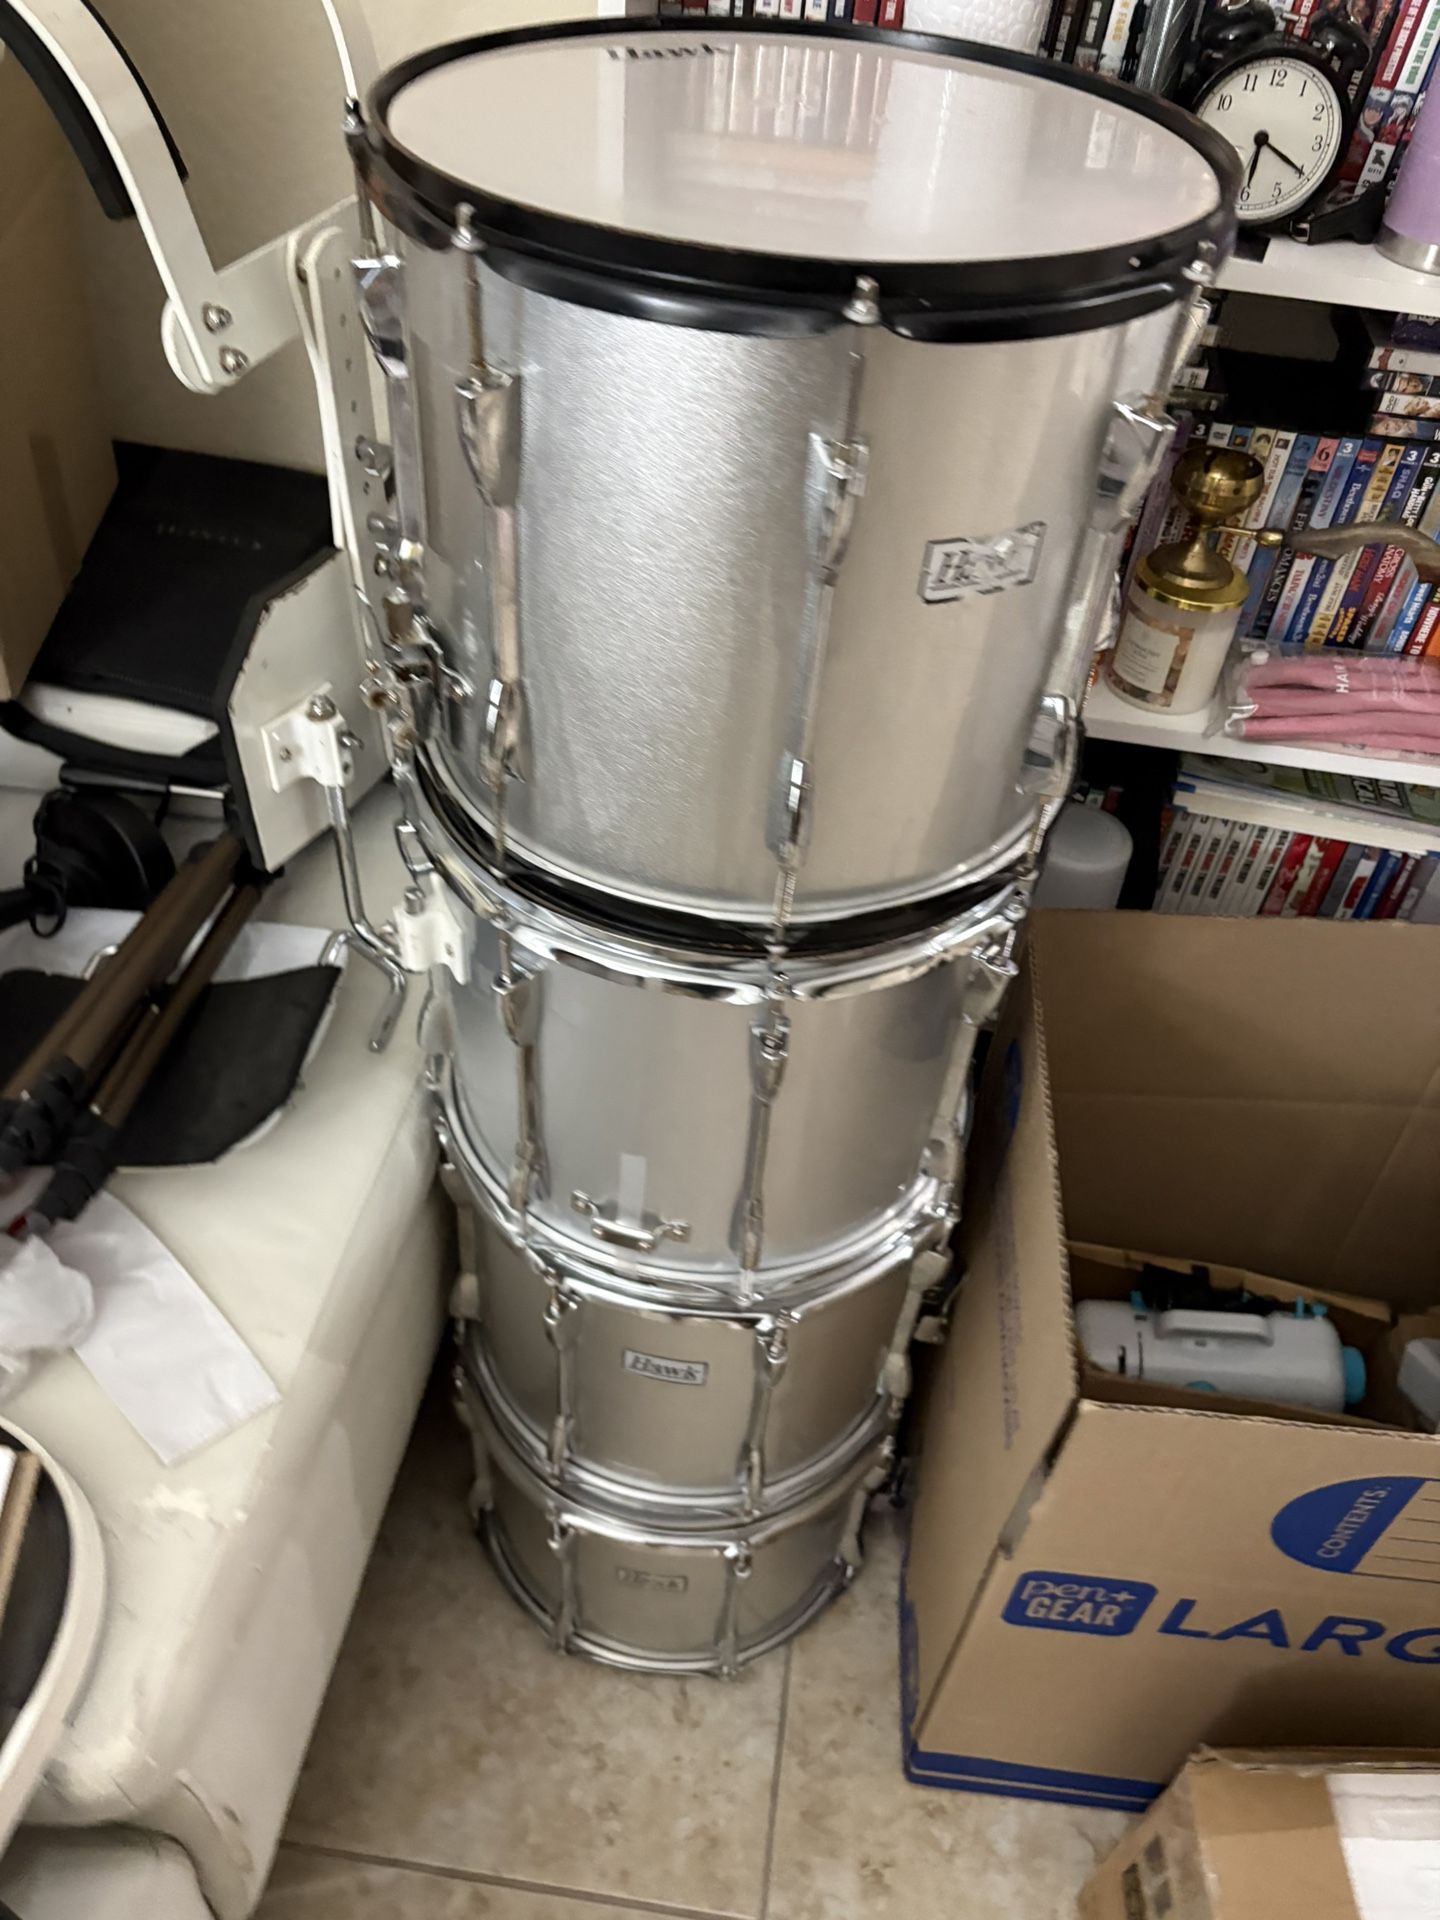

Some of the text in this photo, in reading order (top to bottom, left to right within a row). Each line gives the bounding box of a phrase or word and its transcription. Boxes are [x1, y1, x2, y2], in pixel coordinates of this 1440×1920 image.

[1242, 73, 1258, 92] 11
[1269, 69, 1288, 87] 12
[1299, 79, 1308, 97] 1
[1217, 93, 1233, 111] 10
[1312, 103, 1325, 121] 2
[1311, 135, 1323, 152] 3
[1240, 185, 1250, 202] 6
[1271, 181, 1282, 198] 5
[1195, 424, 1206, 436] 3
[1317, 447, 1330, 462] 6
[1342, 442, 1354, 454] 3
[1406, 450, 1419, 461] 3
[1429, 452, 1440, 464] 3
[1391, 468, 1411, 499] SHAQ
[1337, 482, 1362, 524] Beethoven
[1401, 487, 1420, 519] HANDBAG
[1292, 512, 1308, 533] EPI
[1384, 547, 1405, 578] GROSS
[1266, 547, 1293, 603] OMANCES
[1403, 599, 1424, 624] Hearts
[1414, 606, 1440, 644] NOWHERE
[1409, 644, 1425, 655] TO
[1315, 1486, 1391, 1558] CONTENTS:
[1025, 1596, 1123, 1627] GEAR
[1157, 1599, 1440, 1664] LARG
